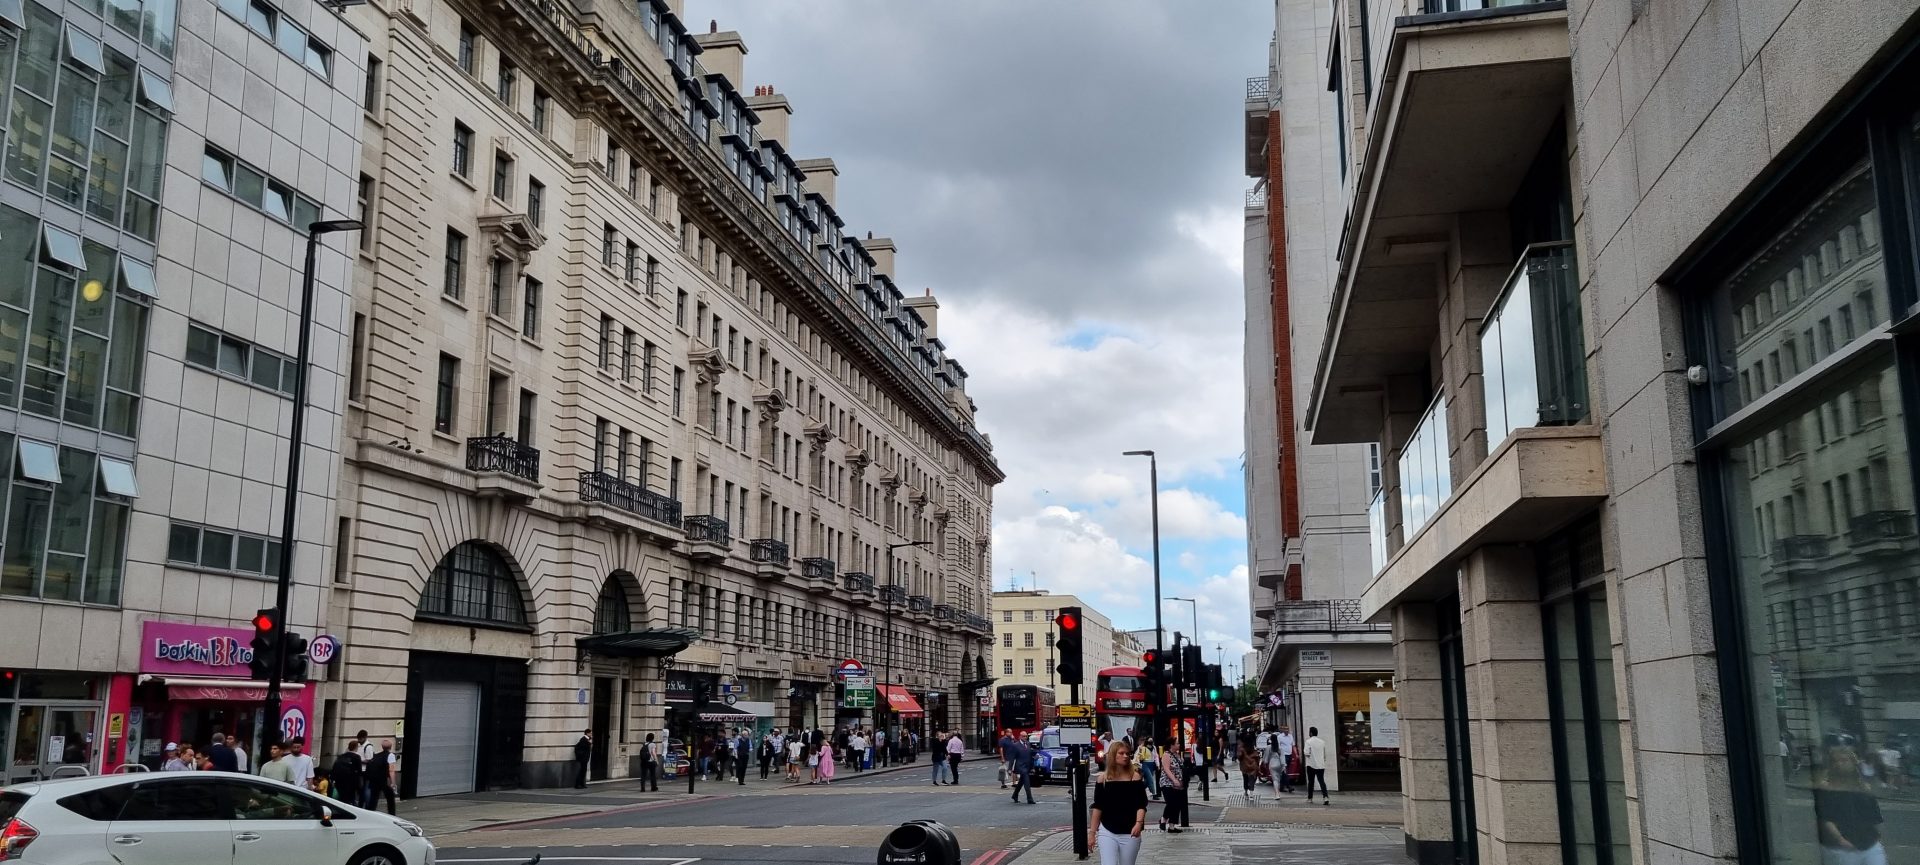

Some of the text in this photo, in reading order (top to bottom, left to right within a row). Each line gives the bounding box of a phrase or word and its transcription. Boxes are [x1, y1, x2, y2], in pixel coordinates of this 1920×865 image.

[156, 637, 254, 665] baskin BR ro
[314, 643, 332, 657] BR
[1135, 701, 1145, 709] 189
[283, 717, 304, 742] BR
